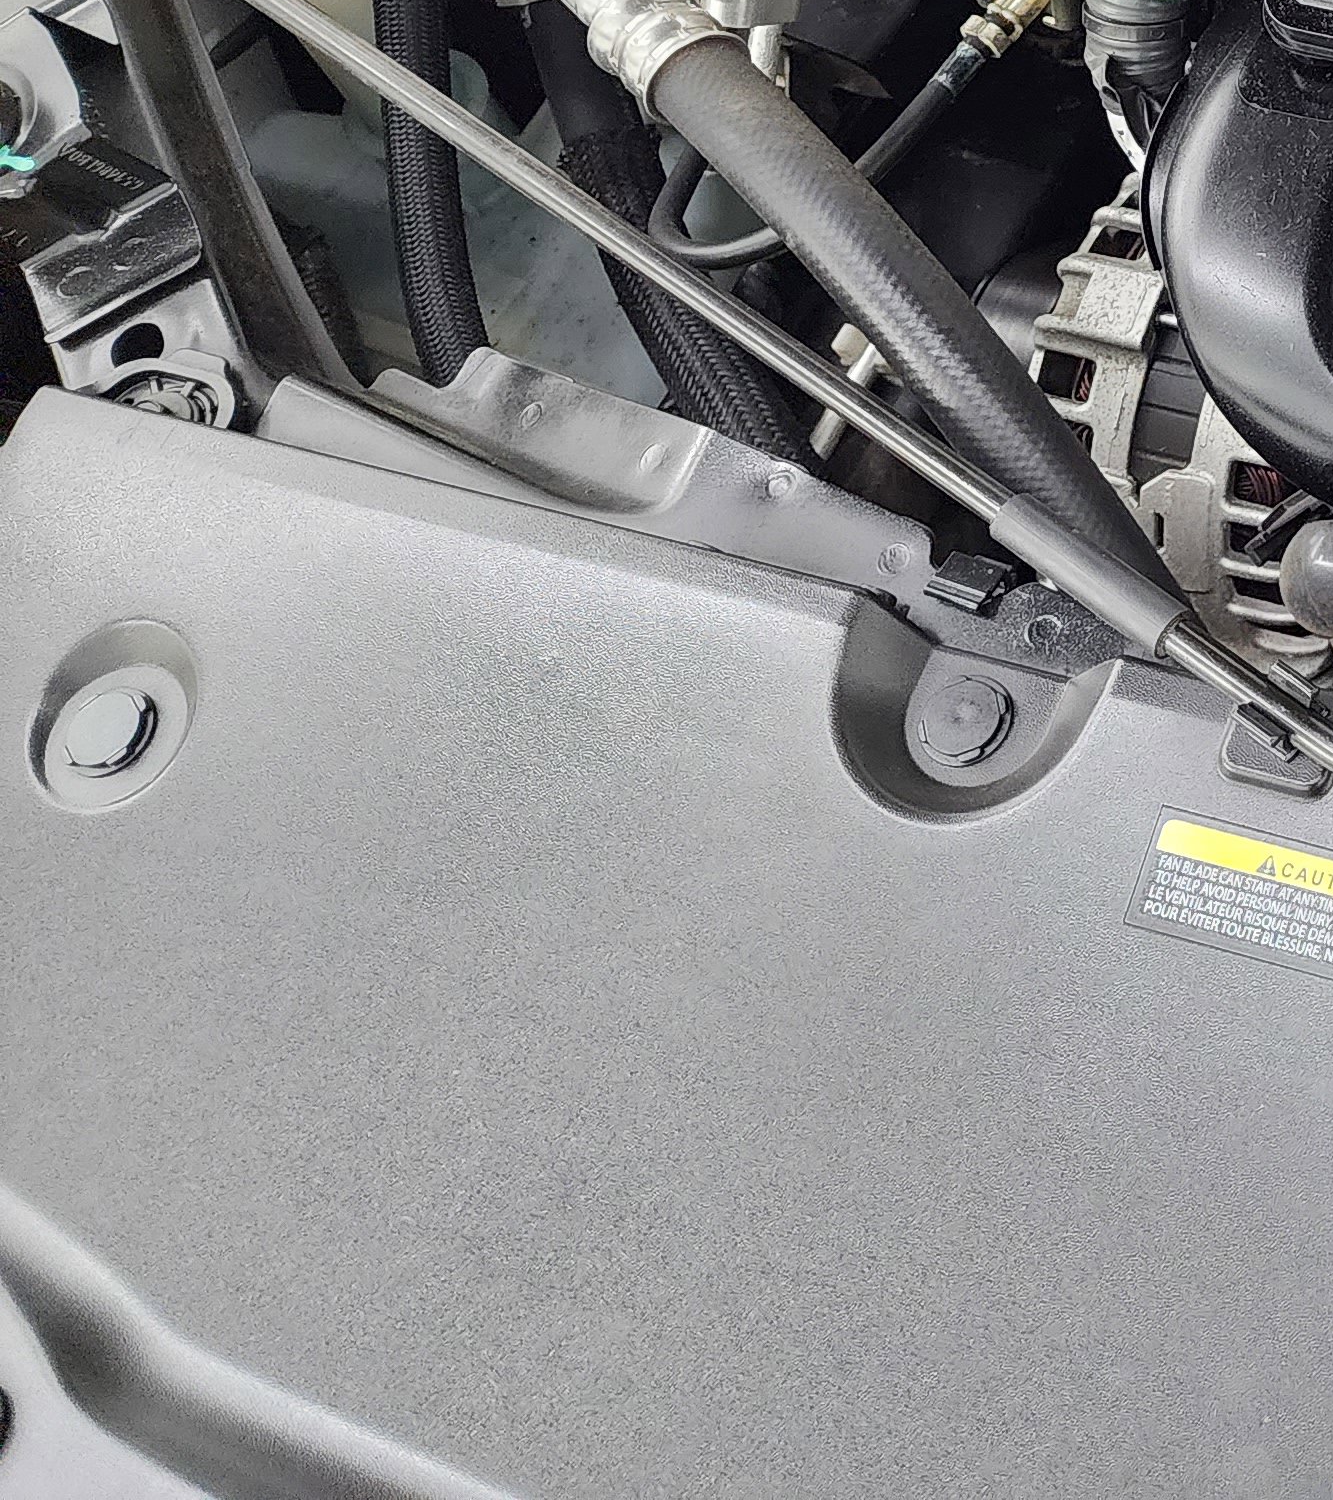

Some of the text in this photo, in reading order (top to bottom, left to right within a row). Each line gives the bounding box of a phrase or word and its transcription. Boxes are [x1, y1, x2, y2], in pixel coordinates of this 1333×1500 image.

[1153, 868, 1172, 886] TO
[1171, 872, 1201, 894] HELP
[1200, 880, 1237, 904] AVOID
[1235, 890, 1295, 919] PERSONAL
[1157, 852, 1182, 872] FAN
[1179, 858, 1219, 882] BLADE
[1216, 868, 1245, 889] CAN
[1242, 875, 1278, 898] START
[1276, 884, 1295, 902] AT
[1292, 888, 1320, 909] ANY
[1142, 898, 1179, 921] POUR
[1220, 919, 1262, 944] TOUTE
[1147, 883, 1165, 901] LE
[1163, 887, 1244, 922] VENTILATEUR
[1243, 909, 1289, 934] RISQUE
[1288, 921, 1307, 939] DE
